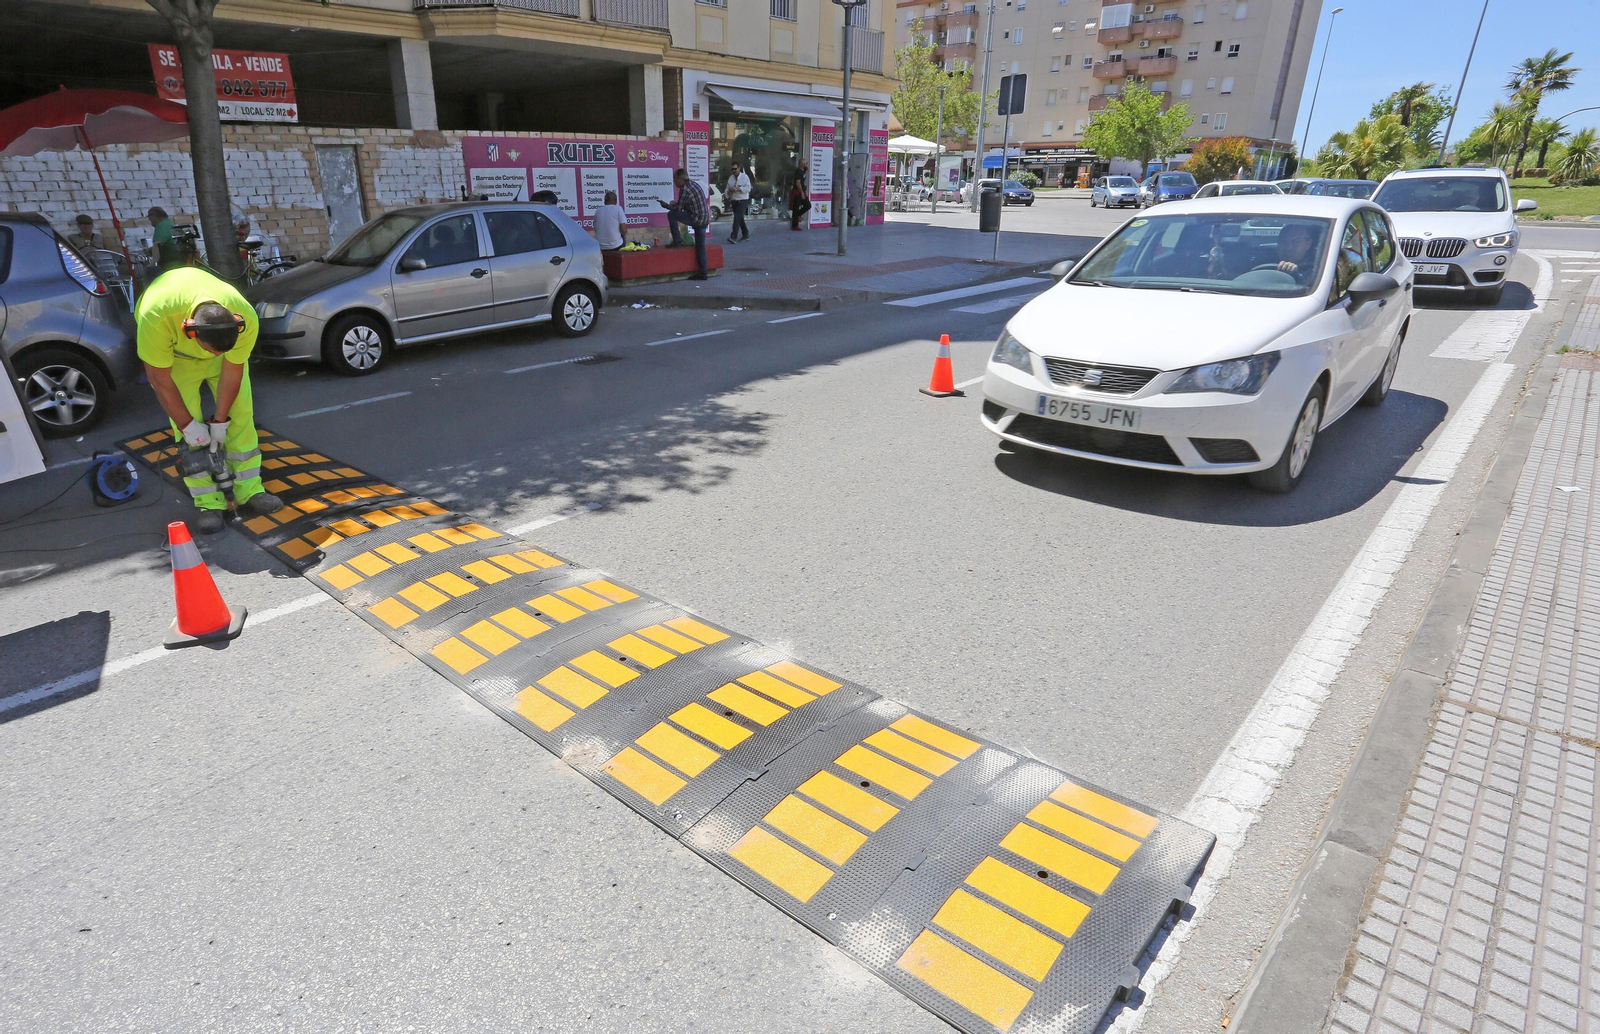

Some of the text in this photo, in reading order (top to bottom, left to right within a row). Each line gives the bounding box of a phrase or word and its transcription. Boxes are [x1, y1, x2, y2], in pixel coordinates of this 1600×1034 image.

[158, 49, 177, 67] SE
[243, 55, 284, 73] VENDE
[221, 77, 288, 98] 842 577
[241, 106, 264, 116] LOCAL
[266, 107, 275, 117] 52
[276, 107, 287, 117] M2
[686, 131, 708, 140] RUTES
[813, 132, 834, 142] RUTES
[870, 136, 887, 145] RUTES
[547, 141, 615, 164] RUTES
[648, 150, 669, 164] Disney
[1427, 265, 1445, 273] JVF
[1048, 399, 1135, 427] 6755 JFN
